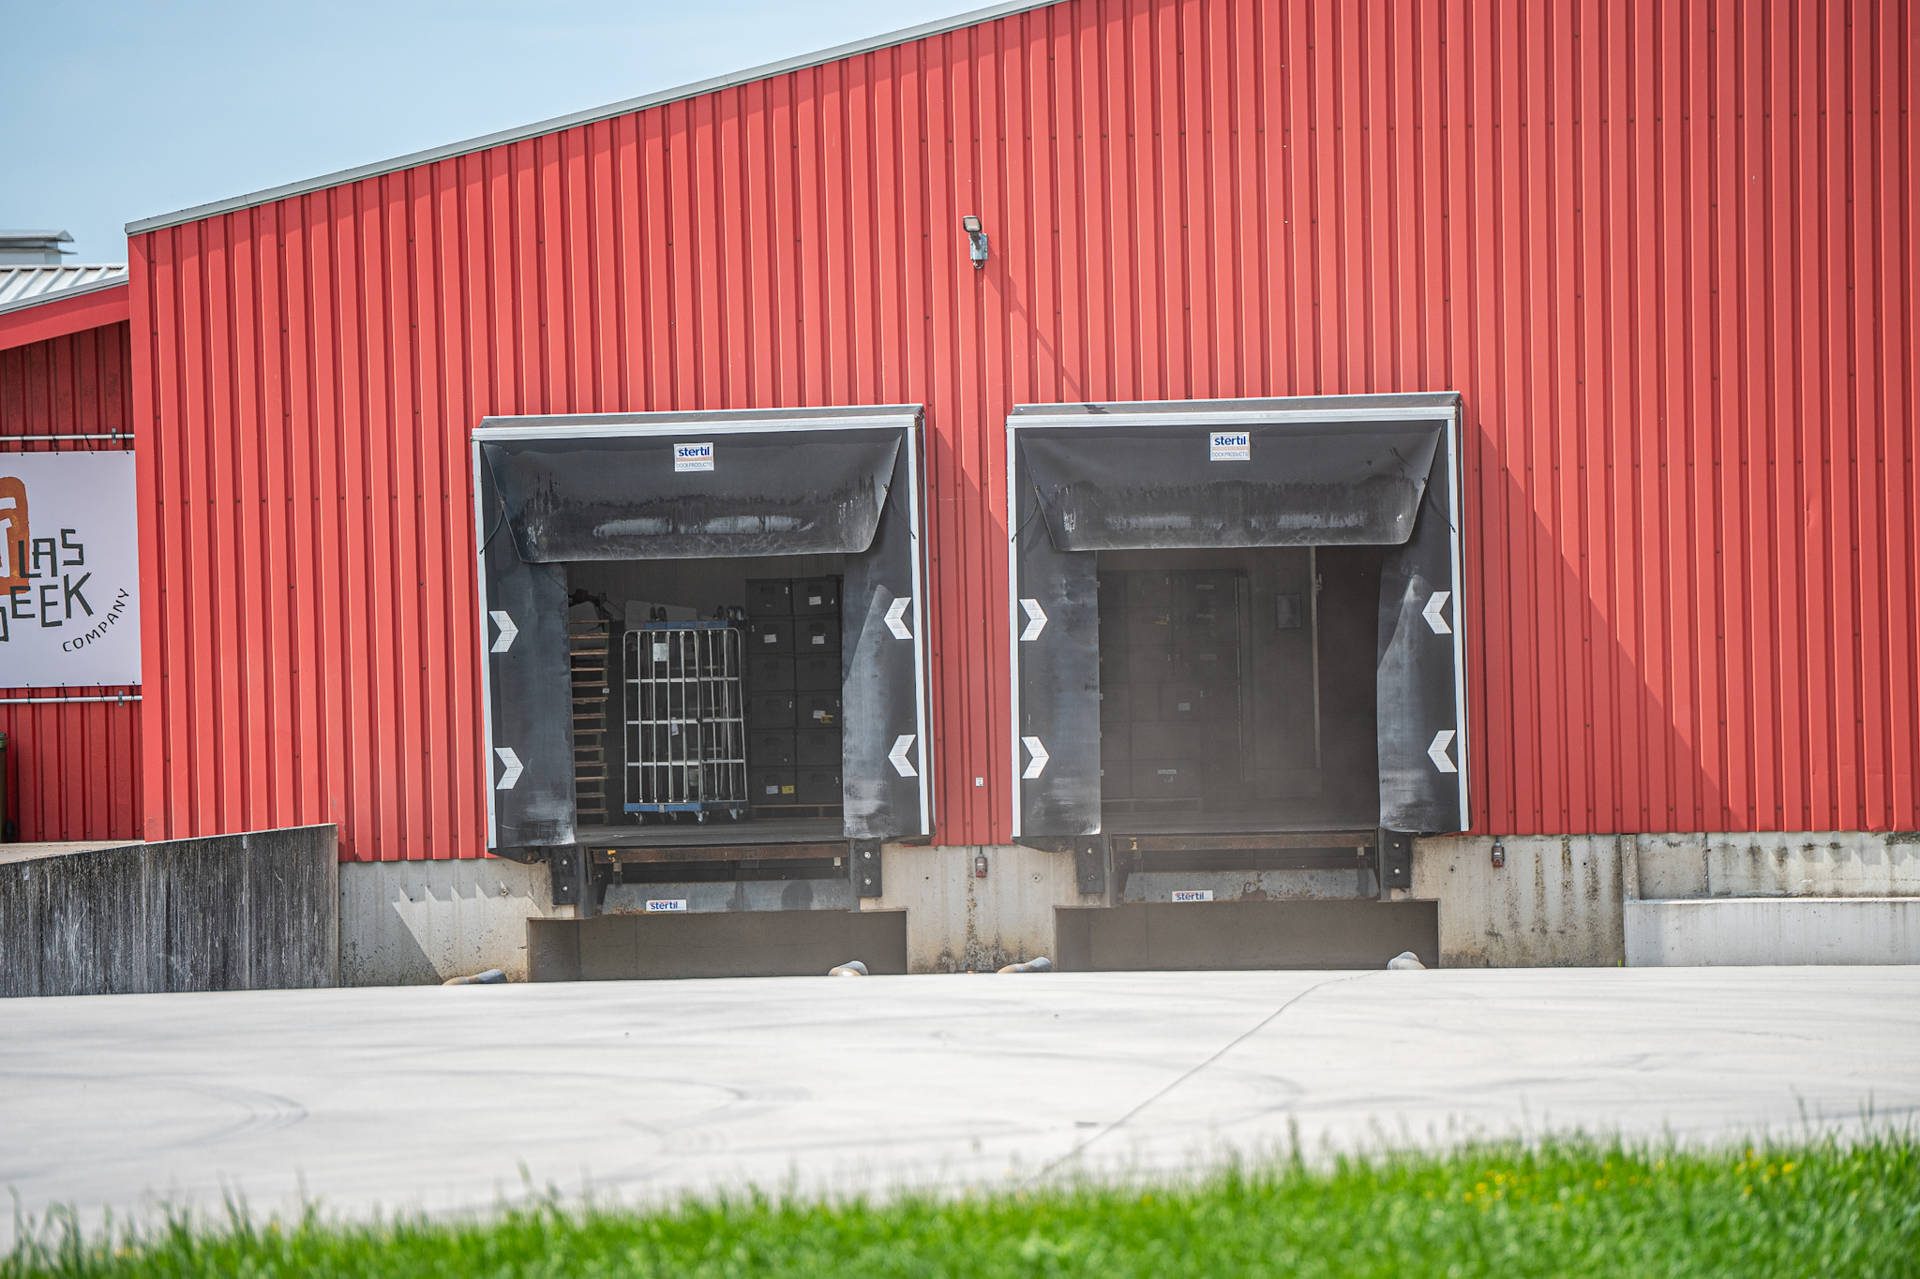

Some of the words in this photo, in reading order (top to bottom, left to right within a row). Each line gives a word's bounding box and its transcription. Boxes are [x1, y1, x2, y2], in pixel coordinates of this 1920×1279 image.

[1214, 435, 1246, 446] stertil
[678, 446, 710, 457] stertil
[62, 588, 130, 653] COMPANY
[1175, 891, 1205, 901] stertil
[650, 901, 678, 910] stertil
